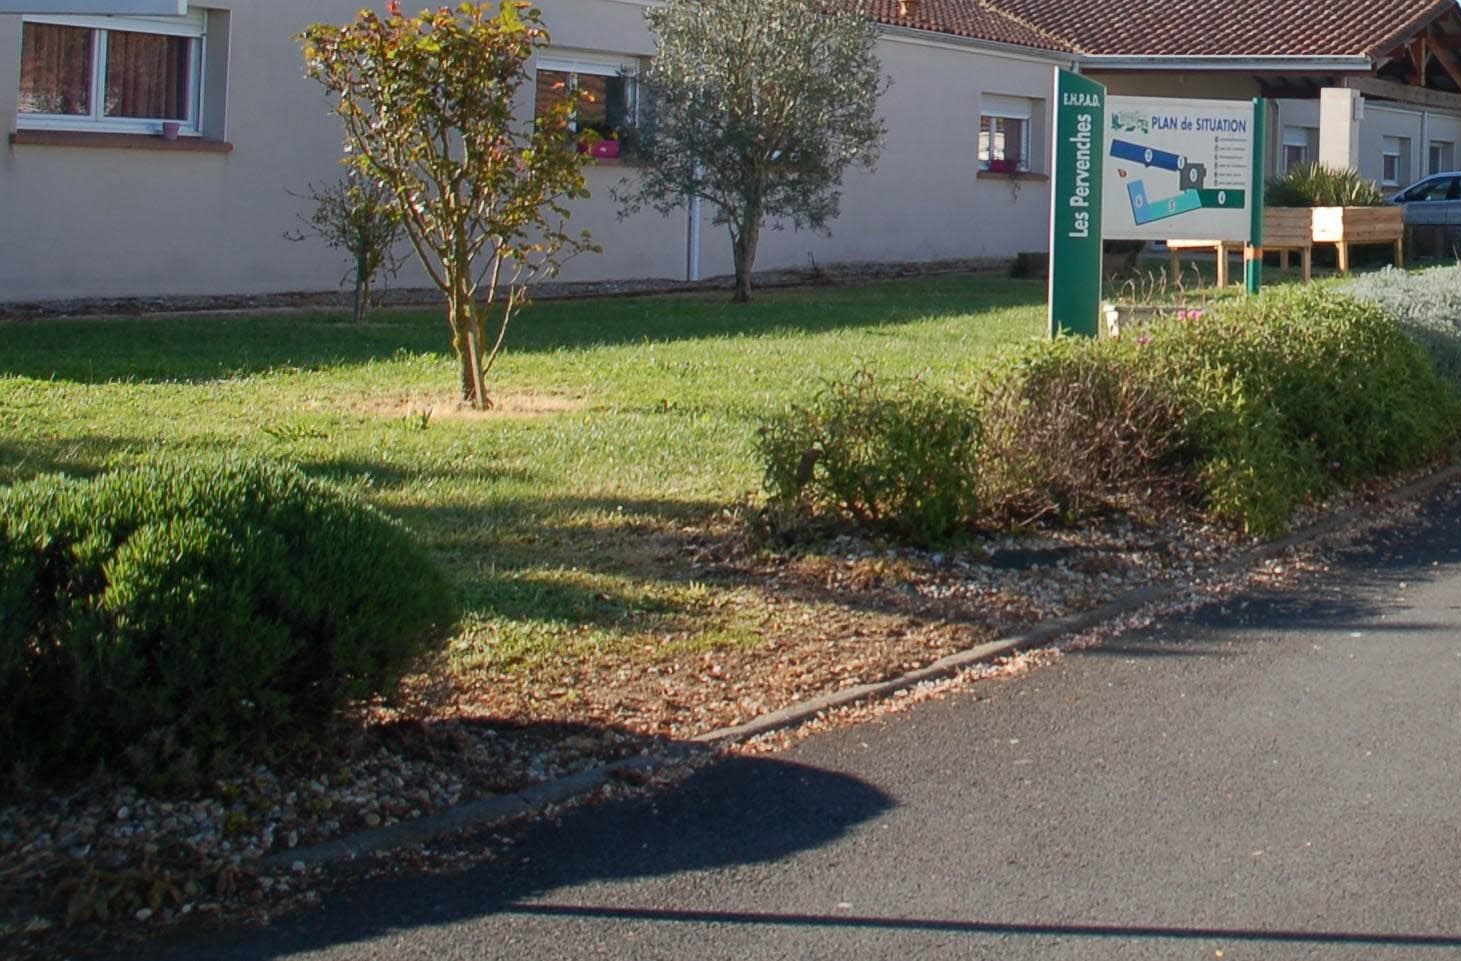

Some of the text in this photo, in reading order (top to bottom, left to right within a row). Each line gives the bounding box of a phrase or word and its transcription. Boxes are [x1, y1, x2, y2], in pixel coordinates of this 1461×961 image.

[1151, 116, 1178, 130] PLAN
[1181, 117, 1193, 131] de
[1196, 118, 1247, 133] SITUATION
[1068, 114, 1092, 237] Les Pervenches
